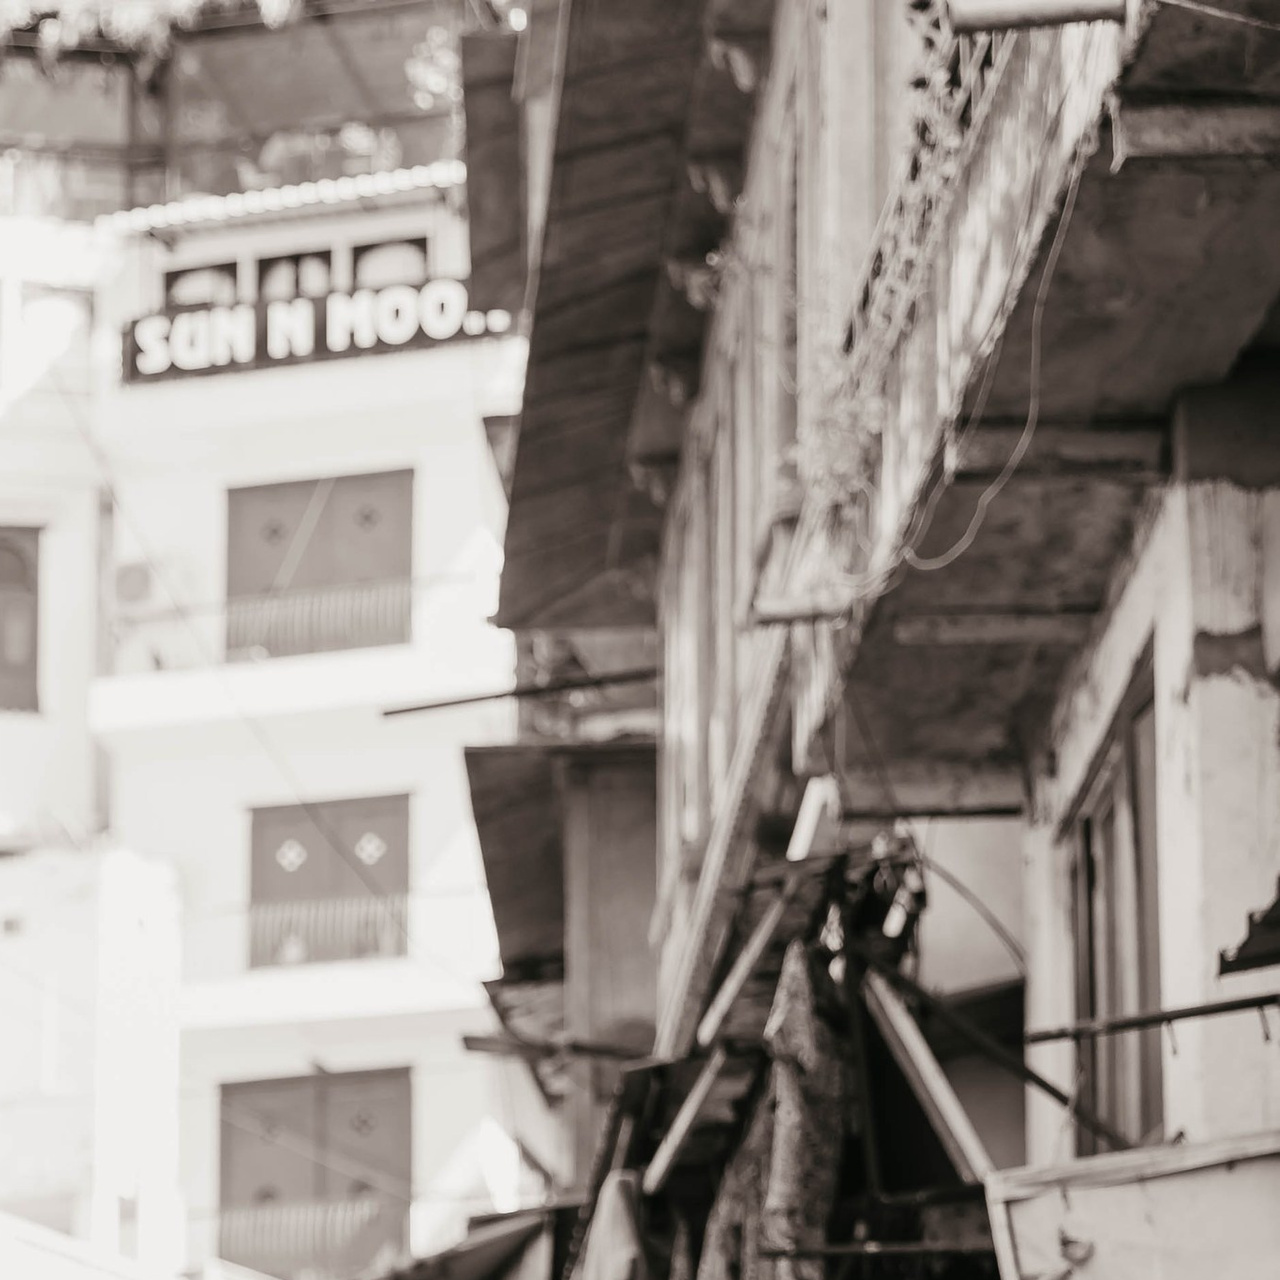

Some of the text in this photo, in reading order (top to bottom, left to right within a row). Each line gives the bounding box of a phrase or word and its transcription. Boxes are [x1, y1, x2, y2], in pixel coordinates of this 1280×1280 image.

[134, 278, 512, 375] SUN N MOO
